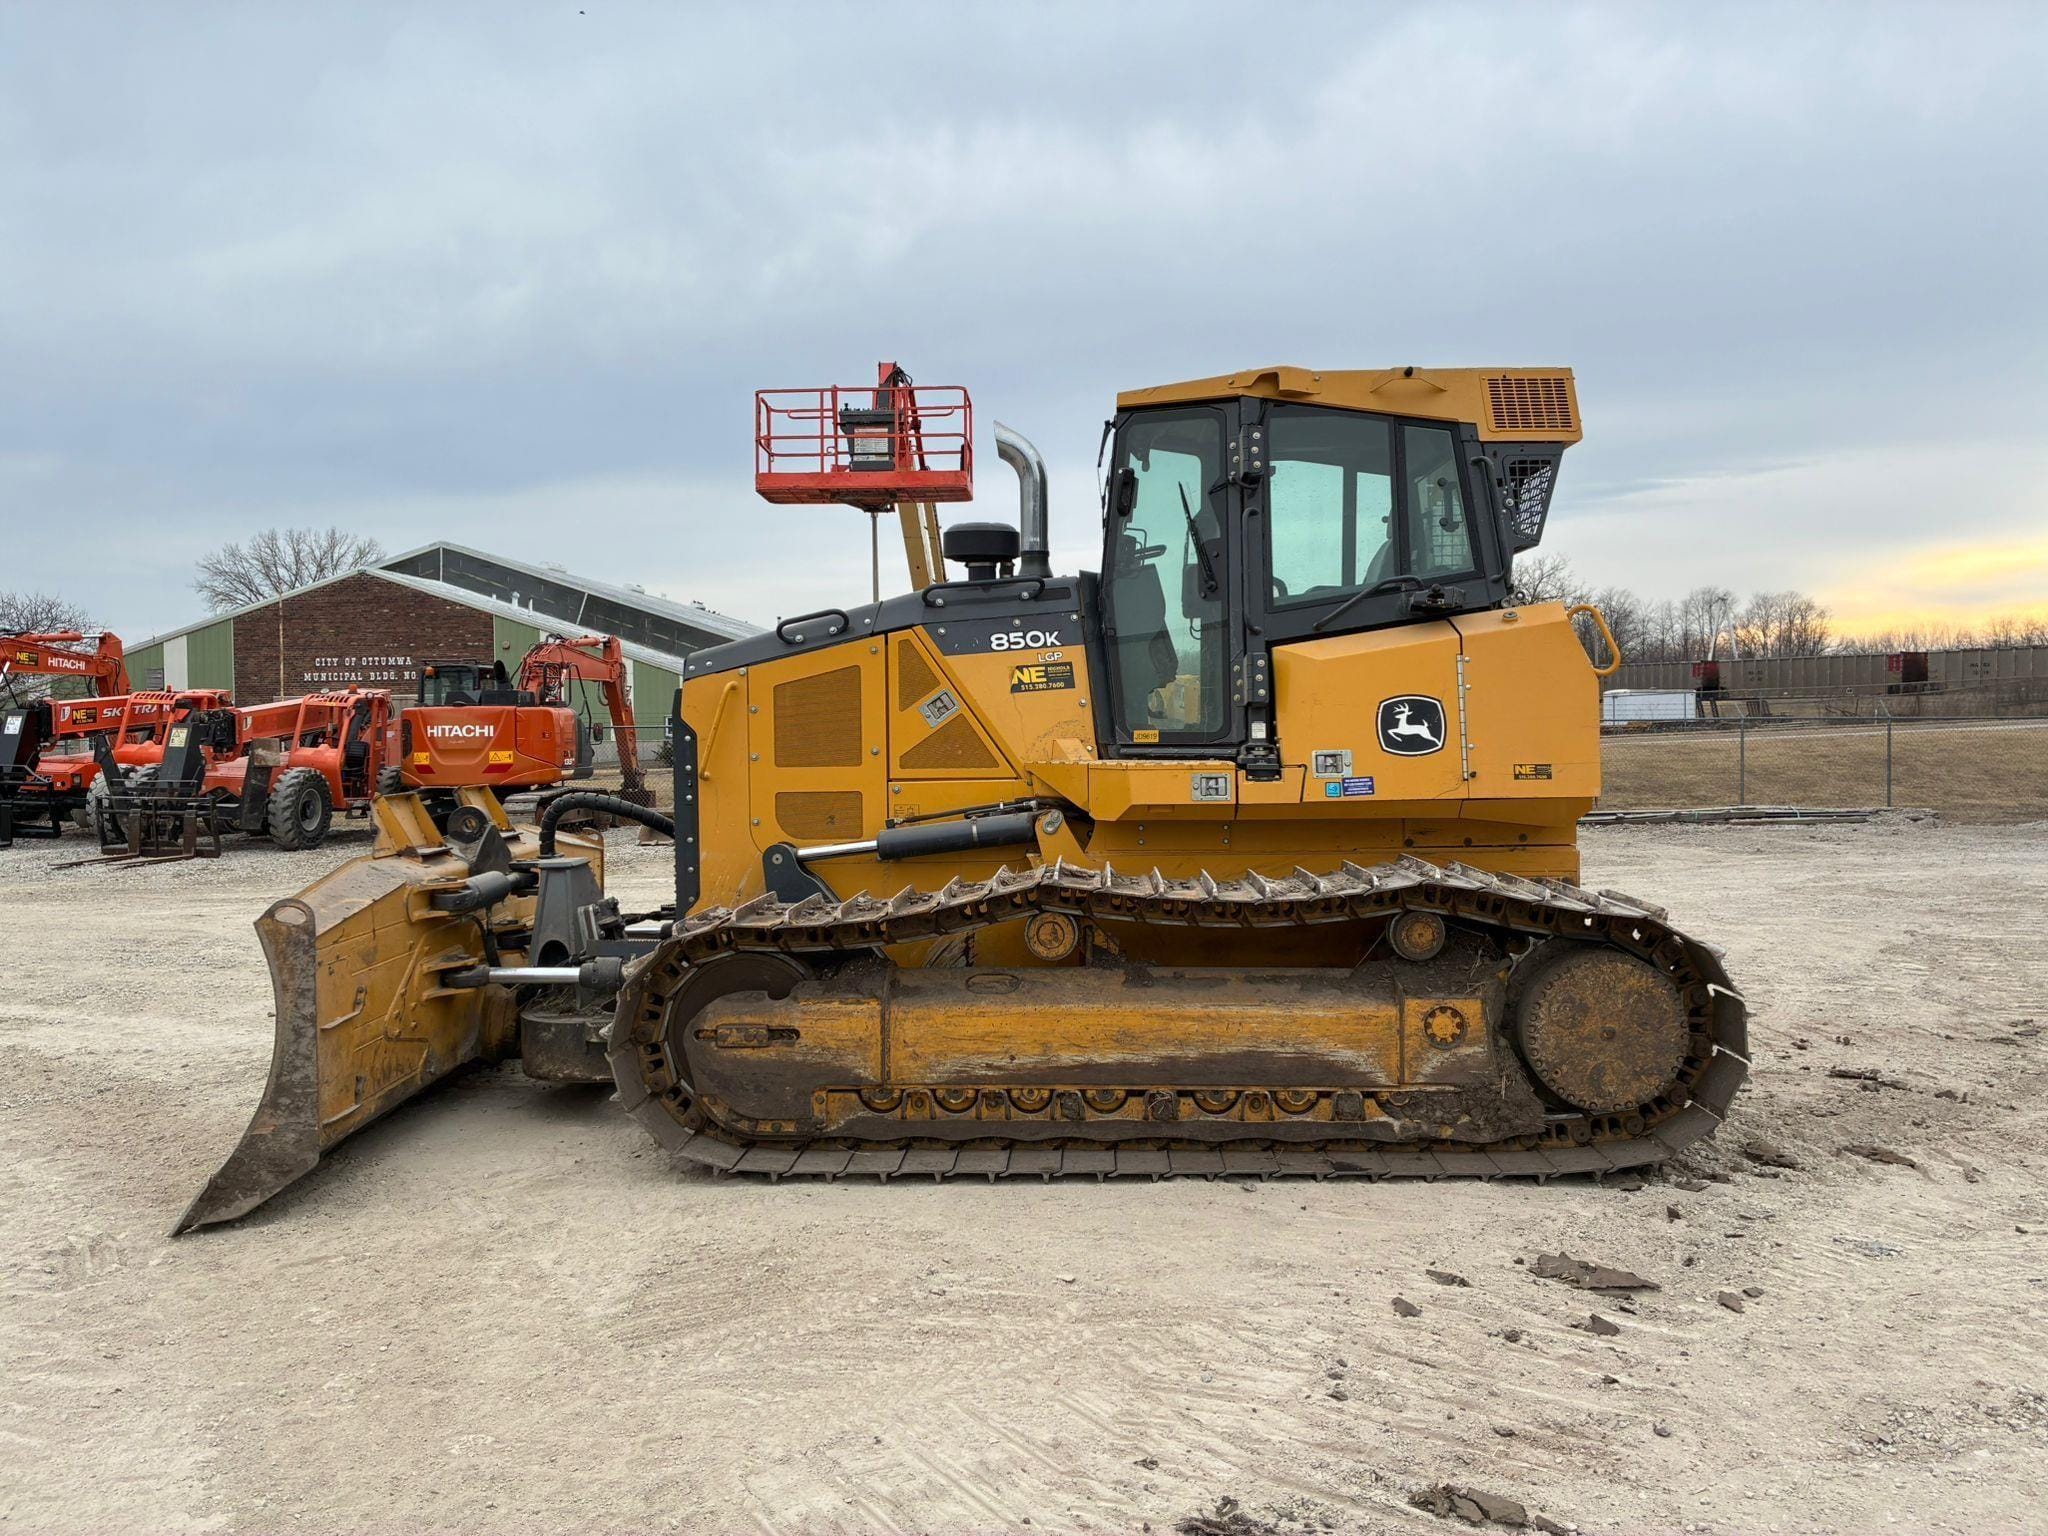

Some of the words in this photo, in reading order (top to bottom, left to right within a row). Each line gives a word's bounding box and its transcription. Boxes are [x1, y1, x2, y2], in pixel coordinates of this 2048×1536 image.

[990, 630, 1062, 651] 850K
[16, 651, 30, 661] NE
[315, 657, 339, 667] CITY
[344, 657, 357, 666] OF
[361, 656, 412, 666] OTTUMWA
[1037, 651, 1063, 662] LGP
[47, 656, 86, 671] HITACHI
[304, 672, 363, 682] MUNICIPAL
[369, 671, 398, 681] BLDG.
[1011, 666, 1047, 684] NE
[1020, 681, 1065, 691] 515.280.7600
[72, 709, 88, 720] NE
[426, 725, 494, 738] HITACHI
[1514, 764, 1536, 774] NE
